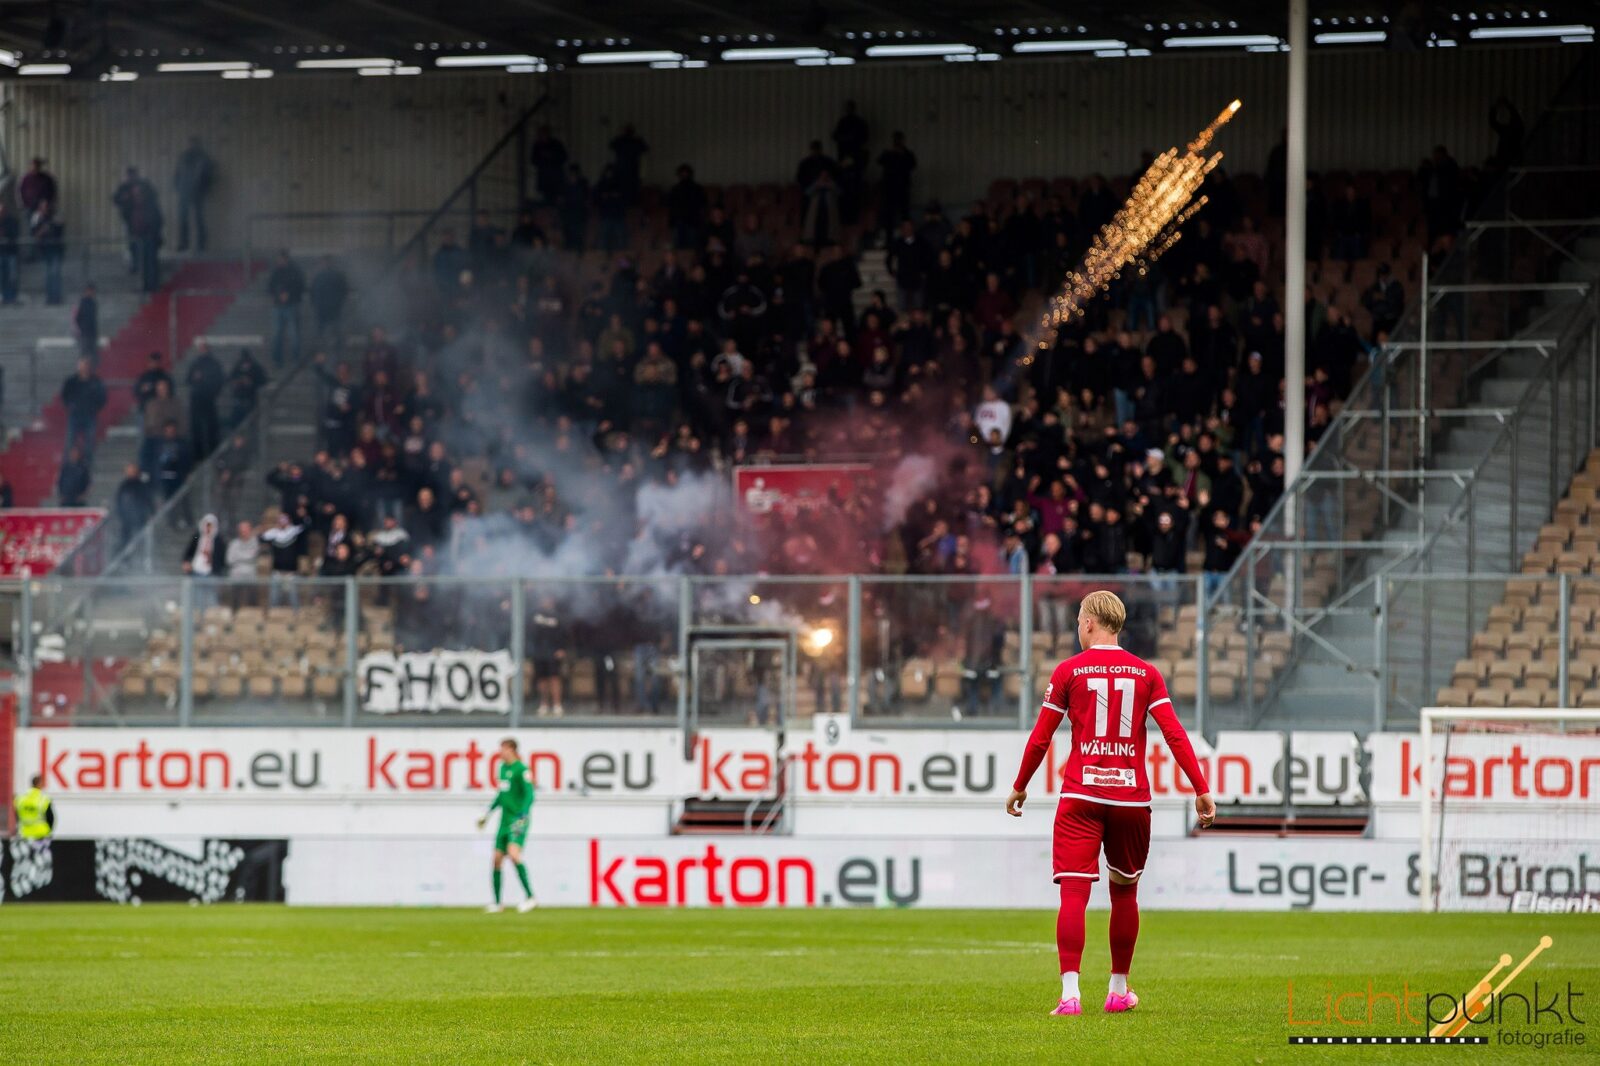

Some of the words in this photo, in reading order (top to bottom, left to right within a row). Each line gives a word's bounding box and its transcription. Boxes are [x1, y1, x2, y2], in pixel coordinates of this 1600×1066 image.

[1073, 665, 1107, 676] ENERGIE
[1109, 665, 1147, 677] COTTBUS
[1086, 677, 1136, 738] 11
[40, 737, 321, 790] karton.eu
[1080, 739, 1136, 757] WÄHLING
[588, 838, 921, 907] karton.eu
[1228, 851, 1386, 909] Lager-
